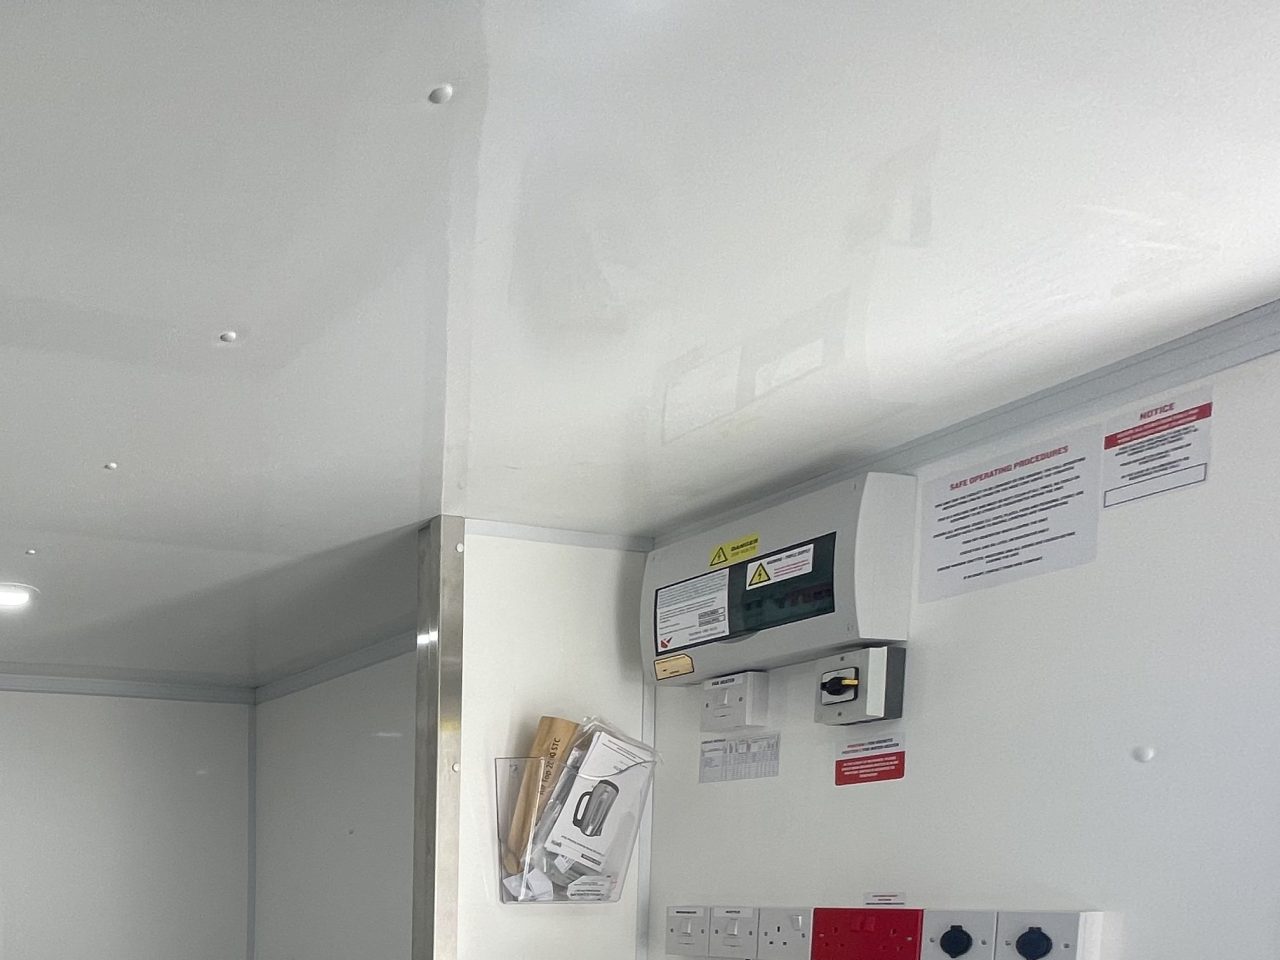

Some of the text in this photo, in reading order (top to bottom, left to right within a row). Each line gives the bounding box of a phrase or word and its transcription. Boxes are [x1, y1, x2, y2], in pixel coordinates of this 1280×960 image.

[1139, 402, 1176, 421] NOTICE
[950, 445, 1069, 491] SAFE OPERATING PROCEDURES
[542, 769, 552, 783] Top
[551, 737, 561, 752] STC
